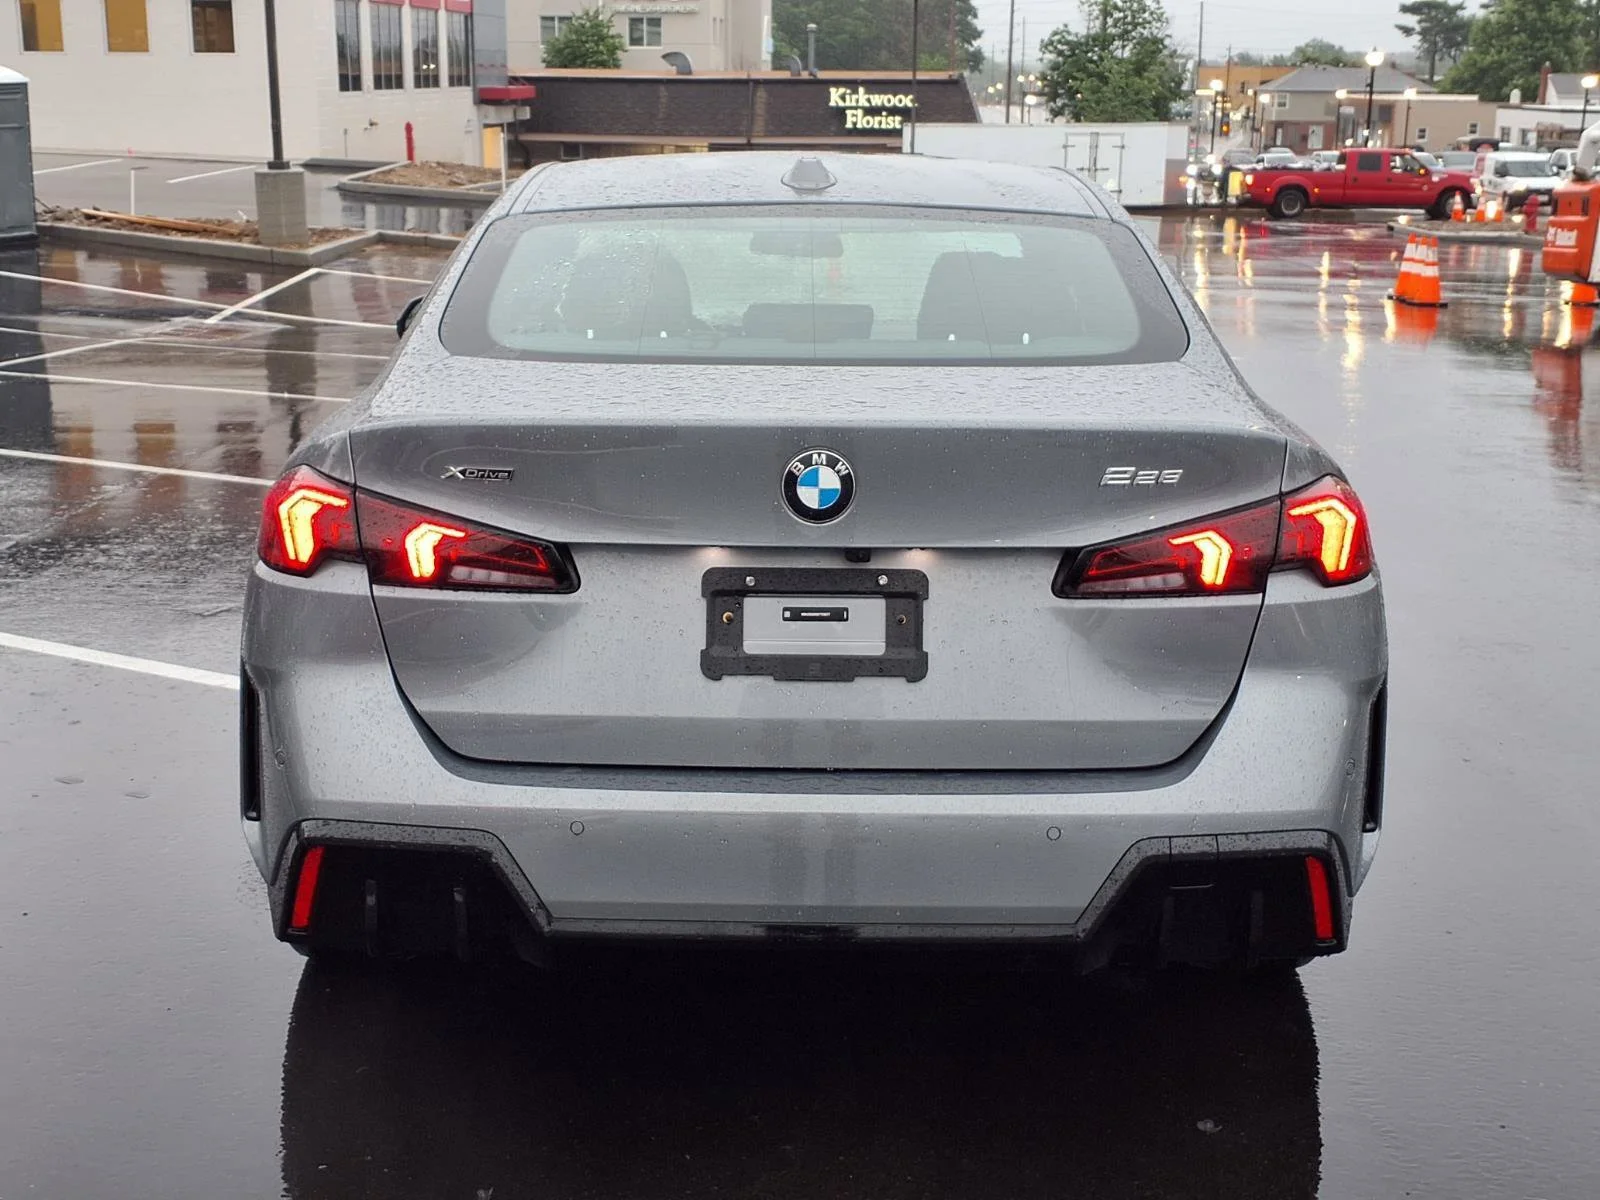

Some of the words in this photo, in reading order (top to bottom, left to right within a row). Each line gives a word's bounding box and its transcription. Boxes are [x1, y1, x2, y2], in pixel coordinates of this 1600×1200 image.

[845, 108, 902, 129] Florist
[790, 453, 849, 476] BMW
[1100, 466, 1183, 486] 228
